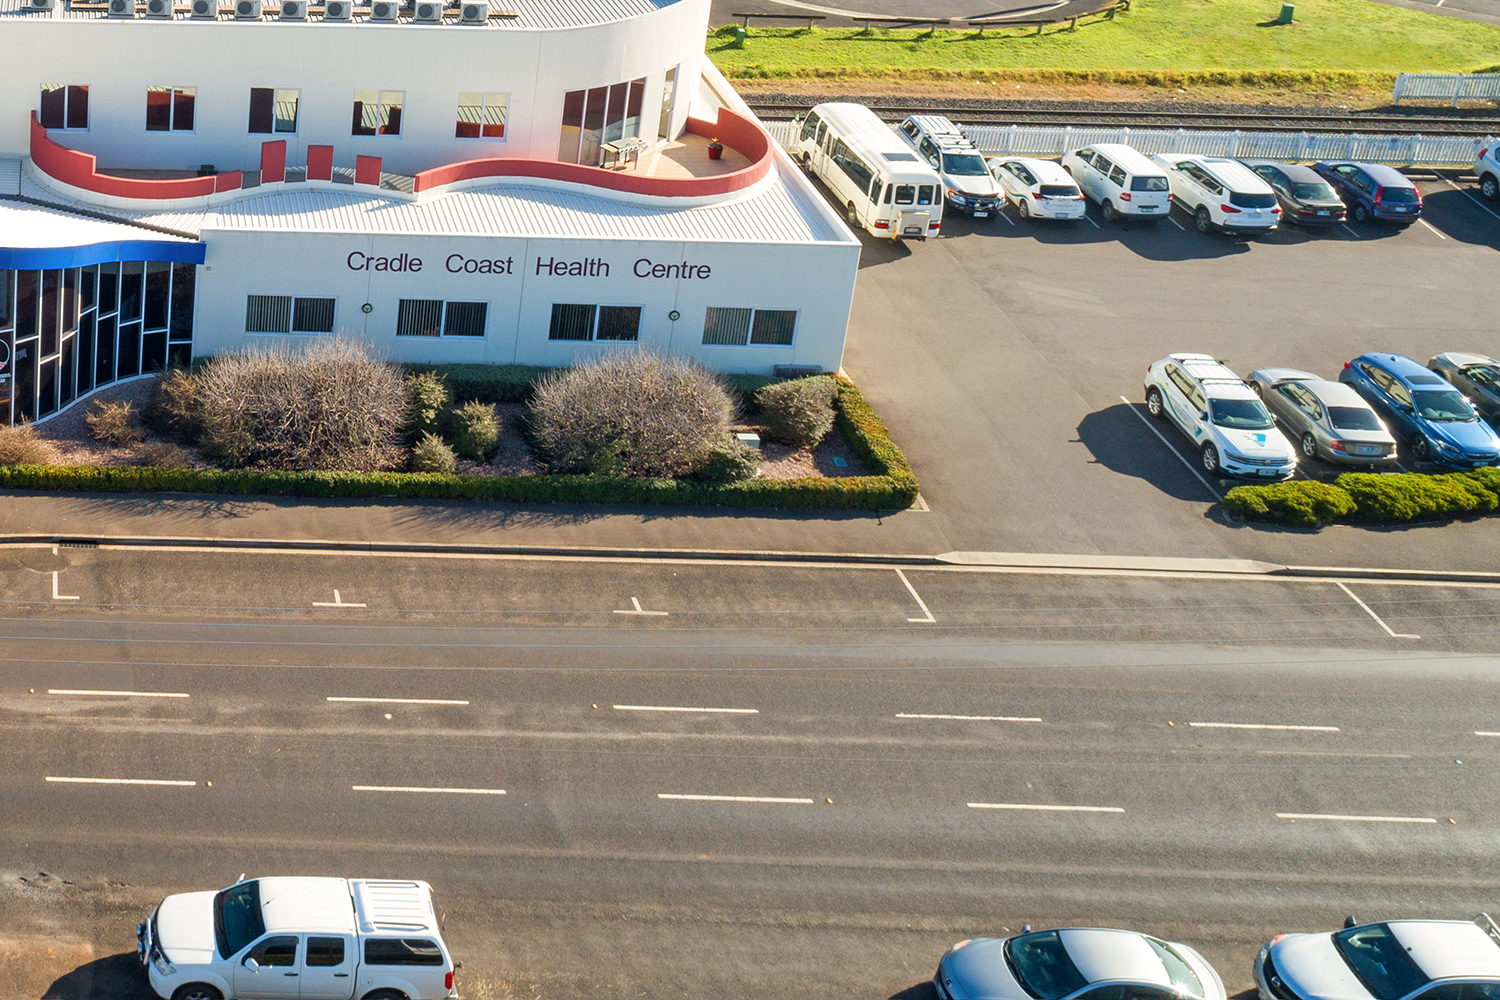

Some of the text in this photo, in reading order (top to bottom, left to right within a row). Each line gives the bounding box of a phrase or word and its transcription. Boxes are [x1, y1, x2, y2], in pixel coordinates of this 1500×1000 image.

[348, 252, 710, 279] Cradle Coast Health Centre
